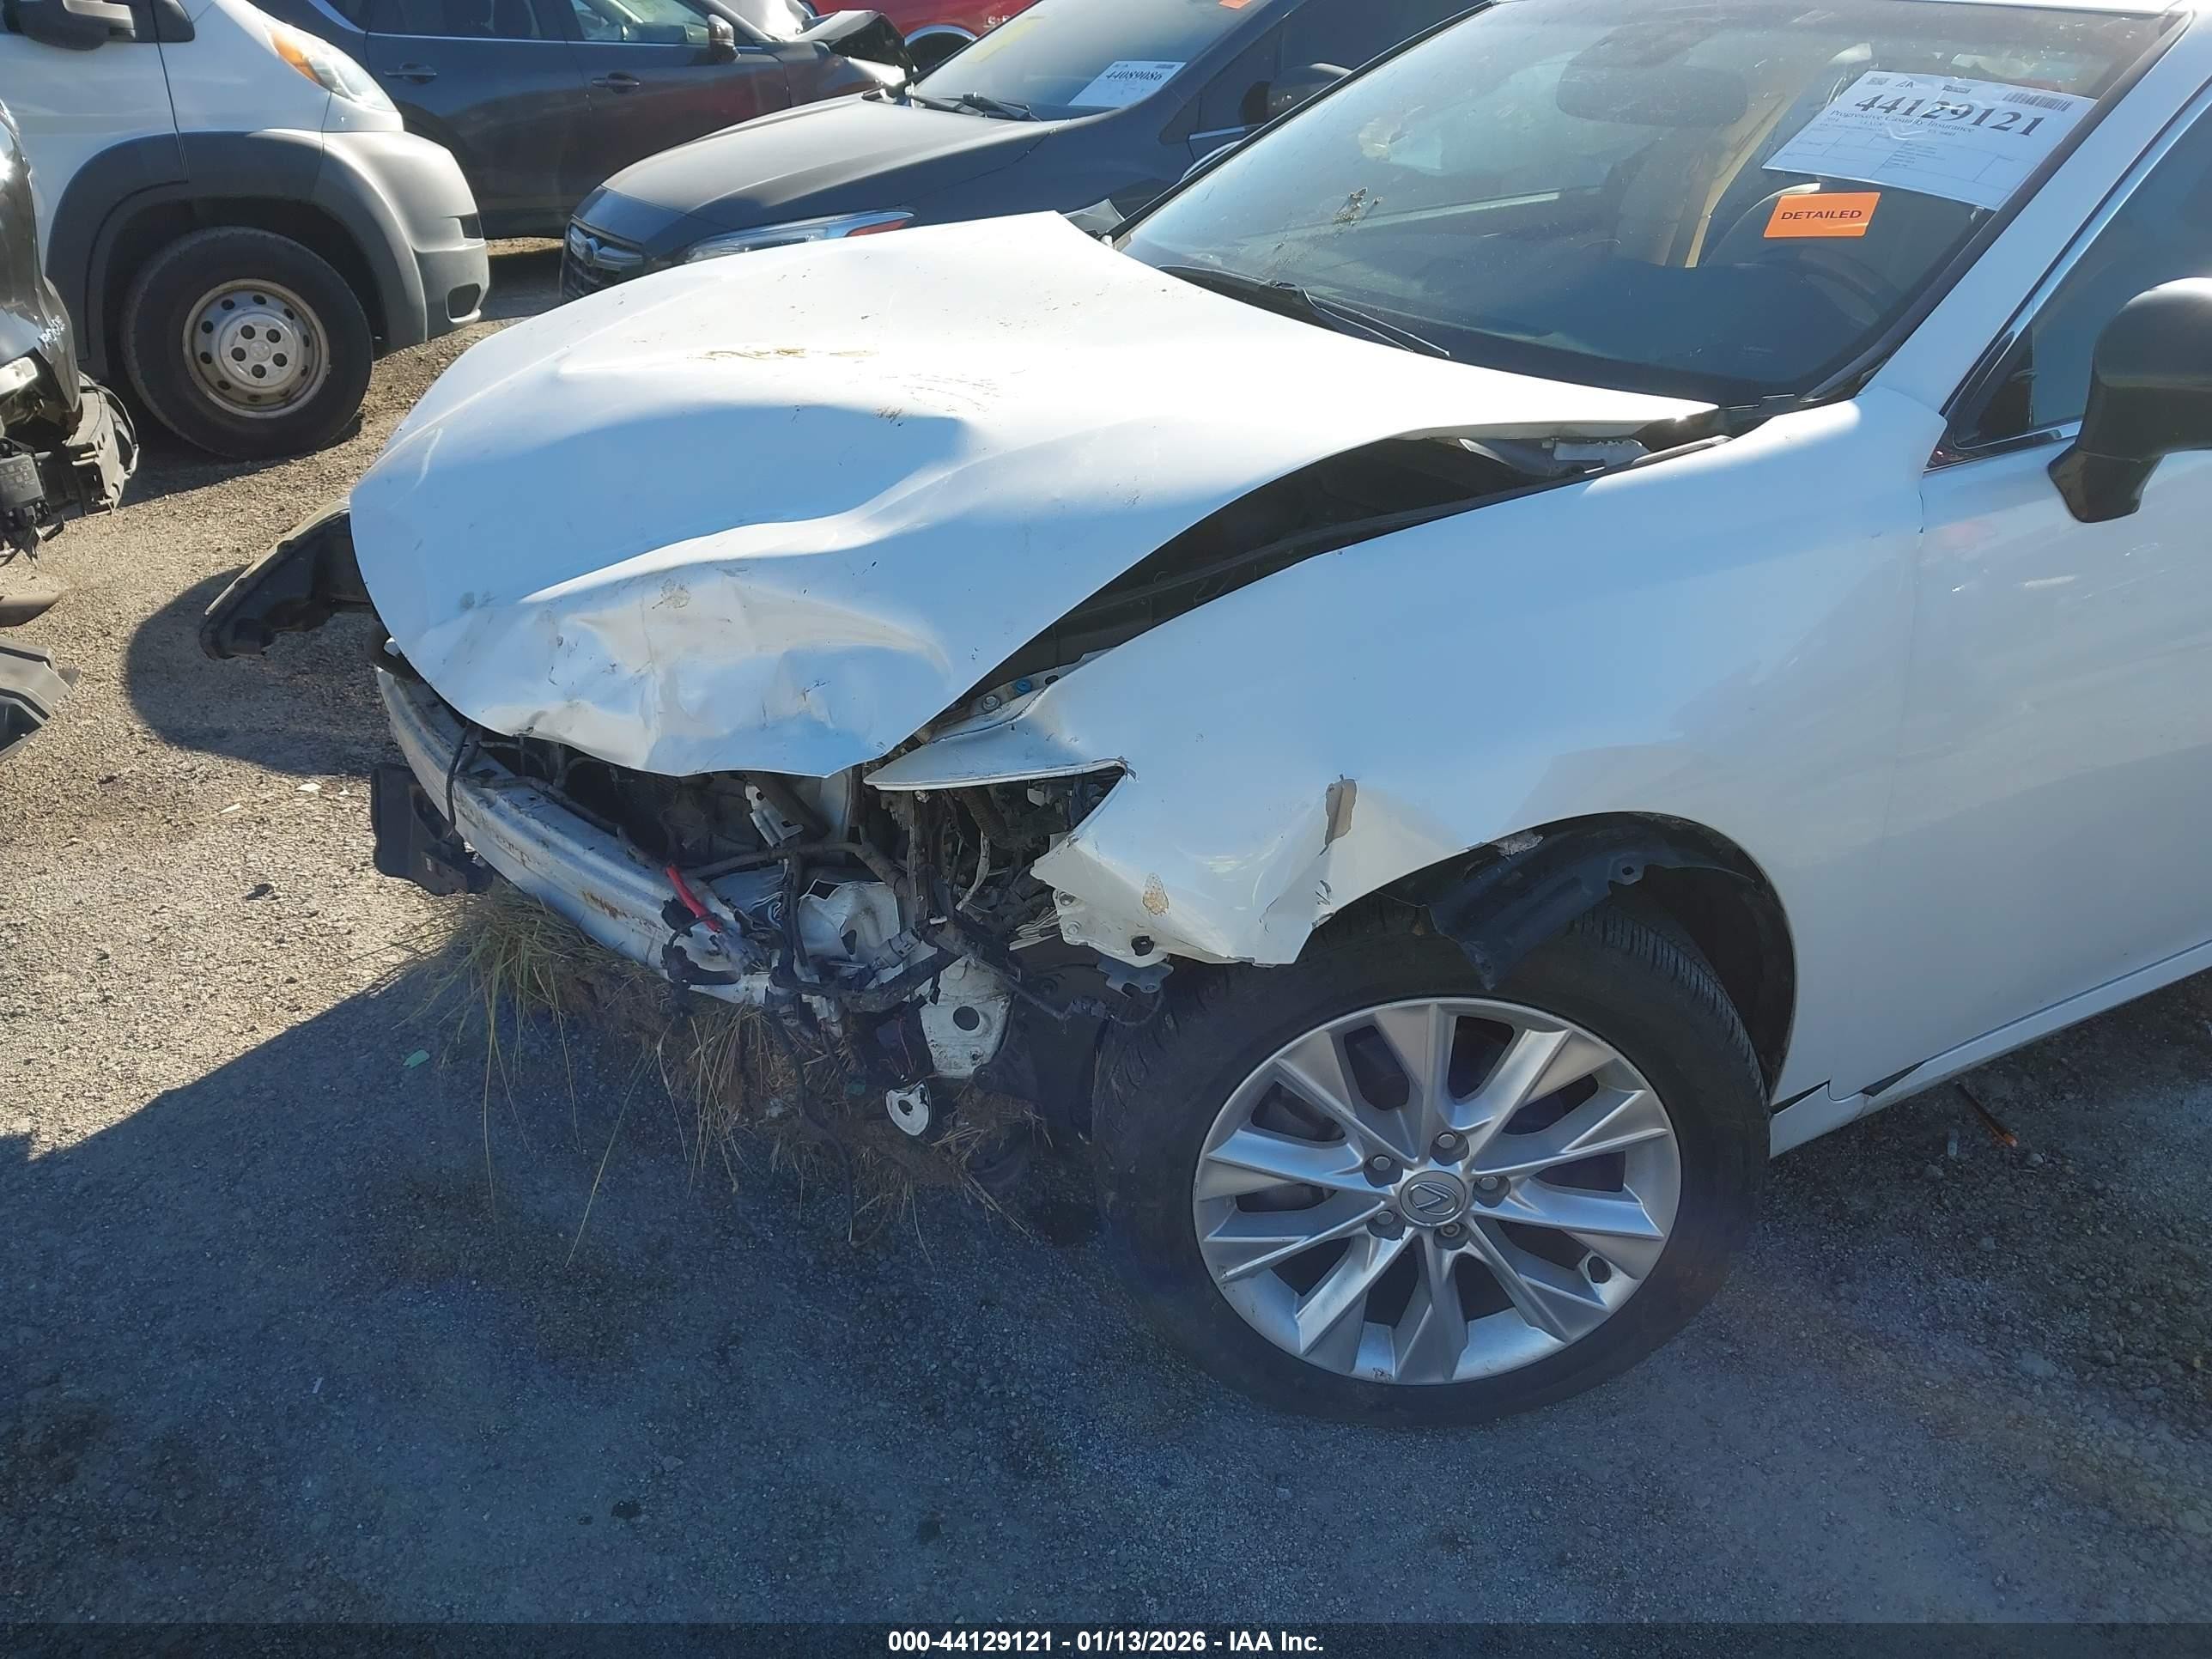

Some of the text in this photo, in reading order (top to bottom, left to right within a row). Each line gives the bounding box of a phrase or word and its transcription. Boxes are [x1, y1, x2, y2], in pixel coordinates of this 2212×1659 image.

[1830, 110, 1886, 121] Progressive
[1927, 121, 1976, 133] Insurance
[1854, 93, 2045, 137] 44129121
[1780, 210, 1863, 220] DETAILED
